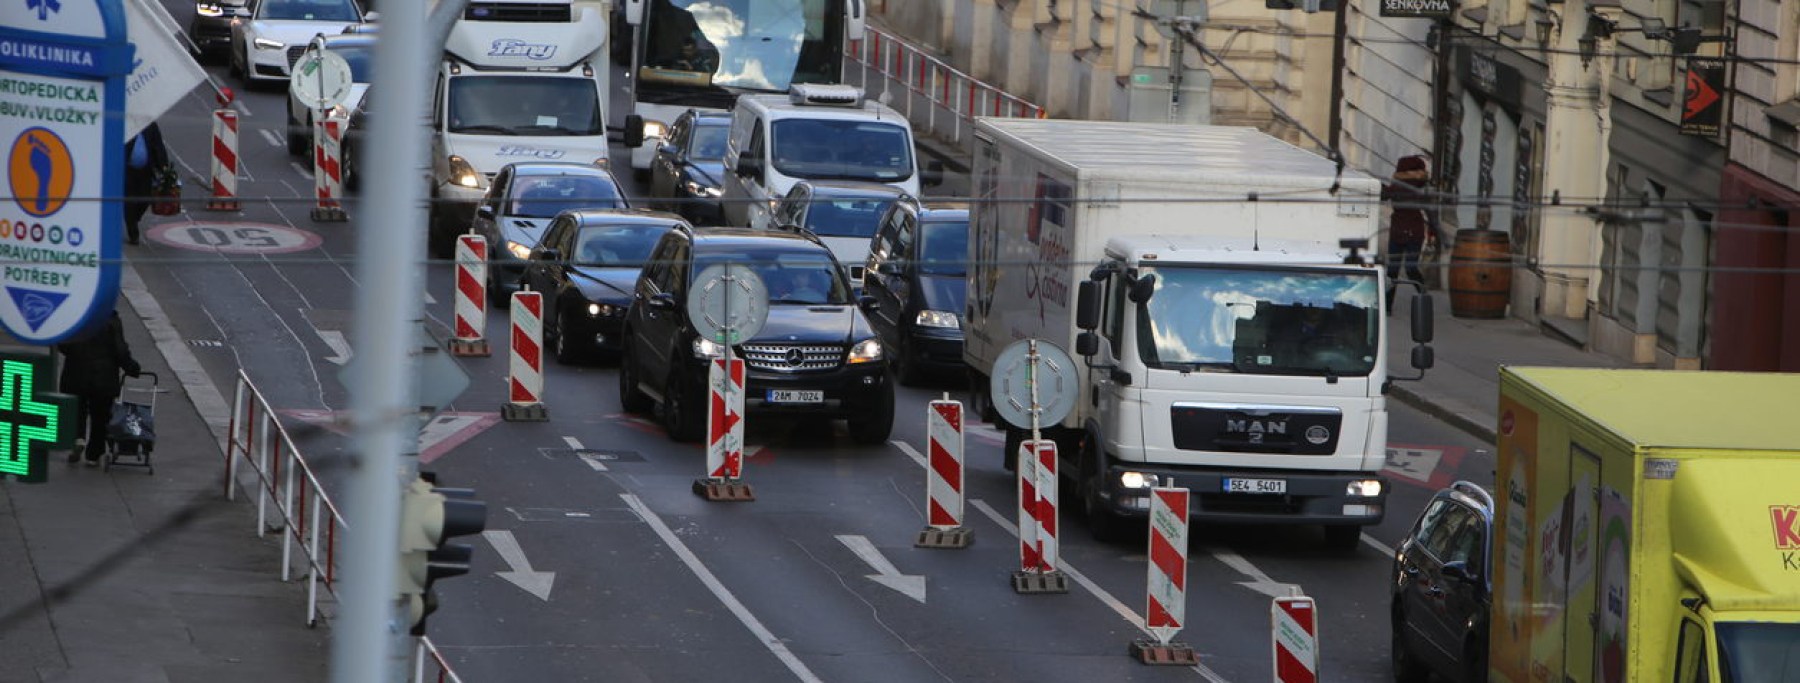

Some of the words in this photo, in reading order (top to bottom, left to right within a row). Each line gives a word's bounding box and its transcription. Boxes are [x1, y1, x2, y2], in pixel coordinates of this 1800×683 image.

[0, 41, 93, 66] OLIKLINIKA
[0, 78, 98, 102] RTOPEDICKÁ
[127, 66, 158, 96] raha
[0, 101, 28, 117] BUV
[0, 243, 97, 268] RAVOTNICKÉ
[4, 266, 71, 287] POTŘEBY
[774, 391, 791, 401] 2AM
[797, 391, 819, 401] 7024
[1226, 419, 1287, 434] MAN
[1231, 480, 1250, 491] 5E4
[1257, 481, 1282, 492] 5401
